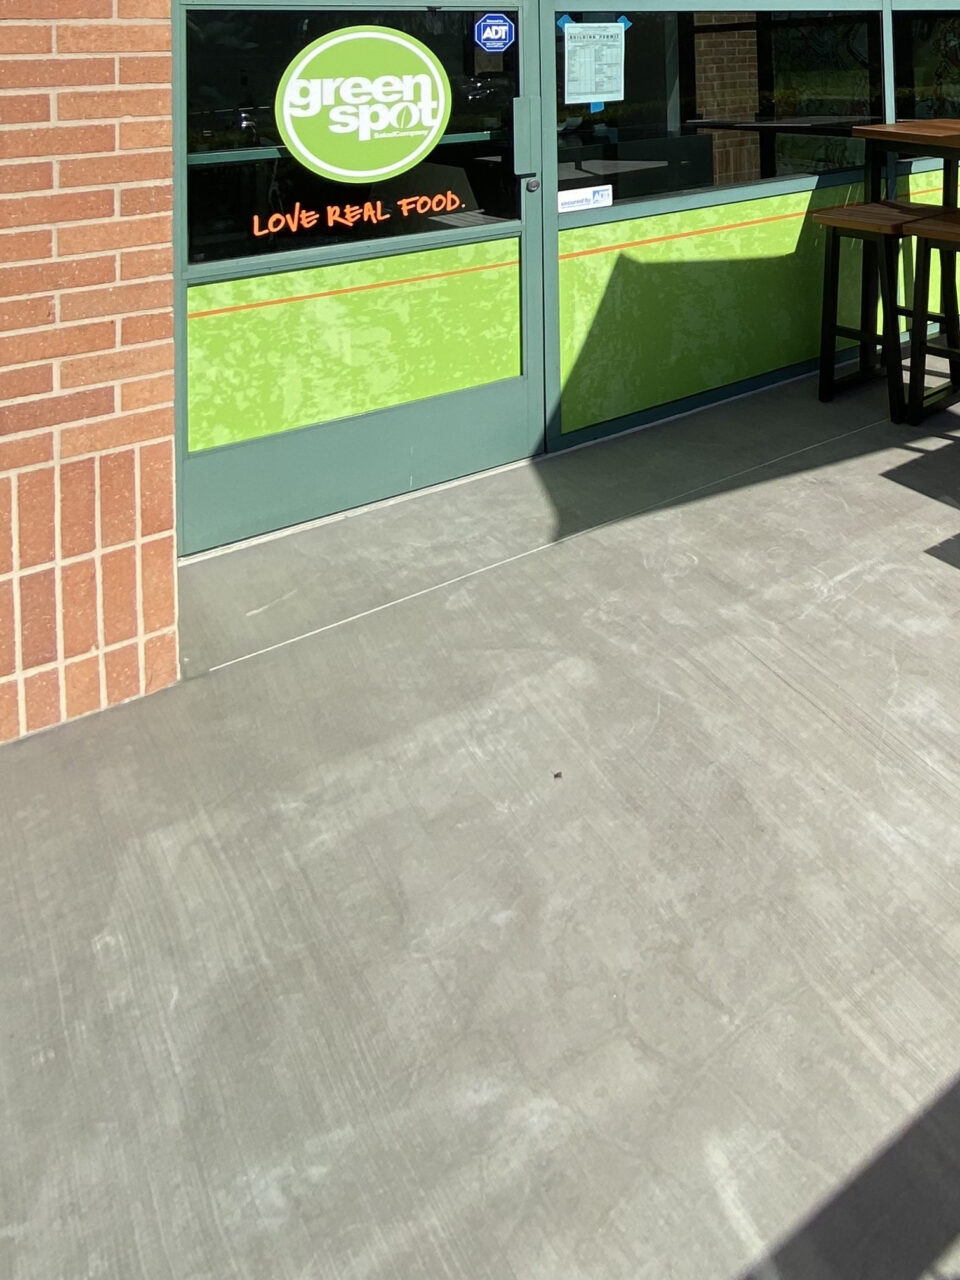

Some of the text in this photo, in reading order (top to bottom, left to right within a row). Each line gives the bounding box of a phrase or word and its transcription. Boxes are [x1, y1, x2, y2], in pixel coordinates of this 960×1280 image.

[482, 25, 508, 40] ADT
[287, 73, 432, 118] green
[328, 101, 438, 142] spot
[252, 190, 466, 237] LOVE REAL FOOD.
